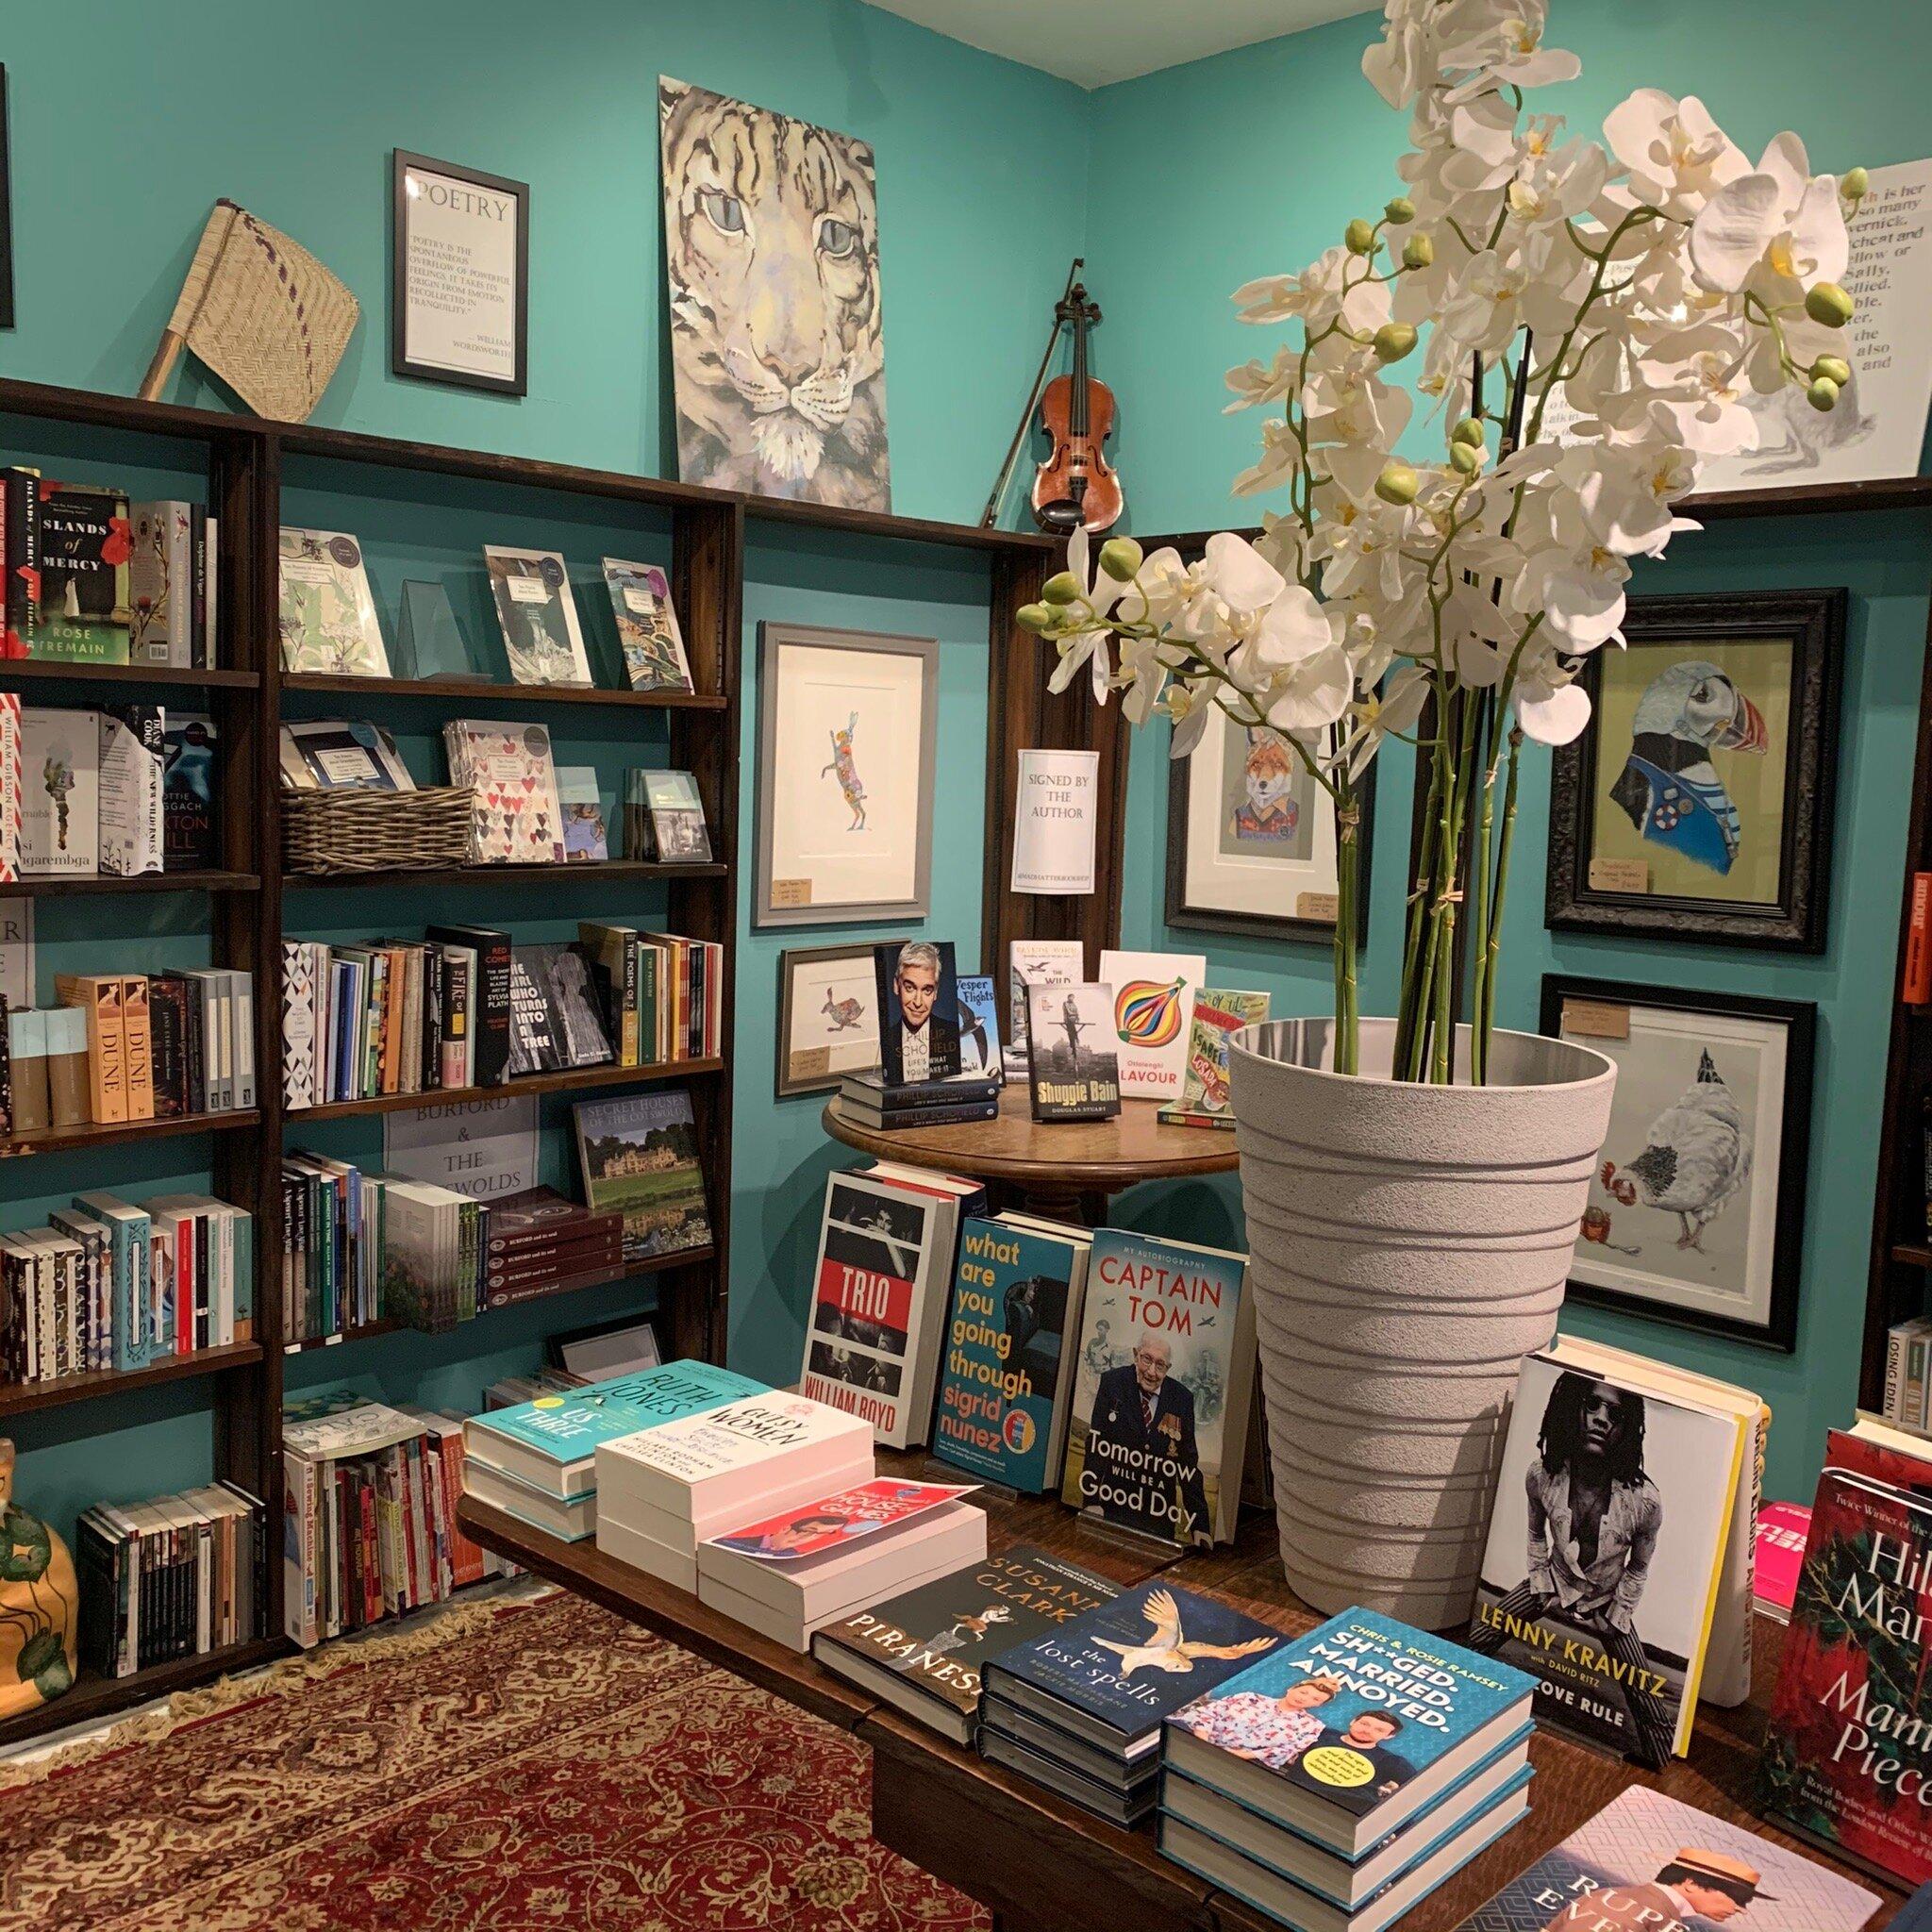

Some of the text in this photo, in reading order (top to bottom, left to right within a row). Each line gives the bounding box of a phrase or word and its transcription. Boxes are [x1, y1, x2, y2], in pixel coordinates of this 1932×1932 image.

[416, 180, 508, 221] POETRY
[1901, 185, 1925, 197] her
[1859, 199, 1922, 215] so many
[1896, 226, 1924, 242] and
[409, 246, 469, 264] SPONTANEOUS
[458, 246, 473, 257] THE
[409, 256, 455, 271] OVERFLOW
[470, 270, 510, 285] POWERFUL
[409, 275, 505, 304] ORIGIN FROM EMOTION
[409, 286, 465, 305] RECOLLECTED
[1855, 329, 1878, 341] the
[1857, 343, 1890, 357] also
[1862, 356, 1891, 371] and
[43, 520, 108, 536] SLANDS
[64, 538, 83, 554] of
[43, 556, 101, 572] MERCY
[53, 626, 92, 640] ROSE
[39, 640, 105, 656] TREMAIN
[143, 720, 153, 746] COOK
[152, 719, 161, 748] DIANE
[4, 716, 13, 804] WILLIAM GIBSON
[1028, 774, 1090, 787] SIGNED BY
[1046, 791, 1072, 803] THE
[149, 780, 158, 855] NEW WILDERNESS
[1031, 807, 1084, 819] AUTHOR
[5, 808, 14, 851] AGENCY
[626, 942, 635, 1001] THE POEMS OF
[452, 976, 466, 1001] FIRE
[510, 987, 538, 1000] WHO
[957, 980, 989, 991] Vesper
[512, 998, 547, 1010] TURNS
[964, 991, 994, 1006] Flights
[517, 1011, 544, 1024] INTO
[519, 1025, 528, 1037] A
[522, 1035, 551, 1049] TREE
[907, 1027, 945, 1041] PHILLIP
[129, 1031, 146, 1091] DUNE
[895, 1041, 957, 1058] SCHOFIELD
[928, 1056, 947, 1064] WHAT
[102, 1033, 120, 1093] DUNE
[1127, 1060, 1164, 1069] Ottolenghi
[1192, 1056, 1218, 1088] LOSADA
[1120, 1070, 1177, 1085] LAVOUR
[588, 1094, 686, 1116] SECRET HOUSES
[1038, 1080, 1118, 1107] Shuggie Bain
[417, 1096, 510, 1121] BURFORD
[458, 1126, 471, 1142] &
[589, 1117, 604, 1127] OF
[444, 1151, 484, 1172] THE
[509, 1236, 533, 1245] BURFORD
[964, 1233, 1021, 1266] what
[508, 1254, 531, 1263] BURFORD
[1123, 1245, 1207, 1270] MY AUTOBIOGRAPHY
[508, 1272, 532, 1281] BURFORD
[960, 1261, 996, 1288] are
[1099, 1256, 1222, 1308] CAPTAIN
[841, 1266, 891, 1320] TRIO
[957, 1288, 994, 1316] you
[1128, 1295, 1192, 1336] TOM
[953, 1319, 1012, 1359] going
[949, 1350, 1033, 1401] through
[1885, 1336, 1900, 1412] LOSING EDEN
[592, 1383, 692, 1416] JONES
[640, 1373, 723, 1405] RUTH
[805, 1374, 897, 1433] WILLIAM BOYD
[943, 1383, 1002, 1422] sigrid
[516, 1408, 593, 1440] THREE
[561, 1407, 603, 1424] US
[707, 1407, 808, 1446] WOMEN
[741, 1407, 809, 1431] GUTSY
[940, 1414, 1002, 1454] nunez
[1089, 1428, 1197, 1483] Tomorrow
[1111, 1465, 1165, 1490] WILL BE A
[1078, 1470, 1197, 1533] Good Day
[1836, 1492, 1928, 1537] Twice Winner of the
[976, 1574, 1079, 1624] CLARK
[845, 1613, 983, 1696] PIRANES
[1081, 1649, 1107, 1664] the
[1349, 1623, 1509, 1693] CHRIS & ROSIE RAMSEY
[1479, 1602, 1668, 1698] LENNY KRAVITZ
[1034, 1640, 1161, 1707] lost spells
[1307, 1642, 1456, 1712] MARRIED.
[1530, 1654, 1601, 1689] with DAVID RITZ
[1288, 1657, 1451, 1734] ANNOYED.
[1533, 1679, 1625, 1727] LOVE RULE
[1806, 1774, 1834, 1797] Royal
[1835, 1790, 1866, 1813] Bodies
[1800, 1786, 1912, 1849] from the London Review
